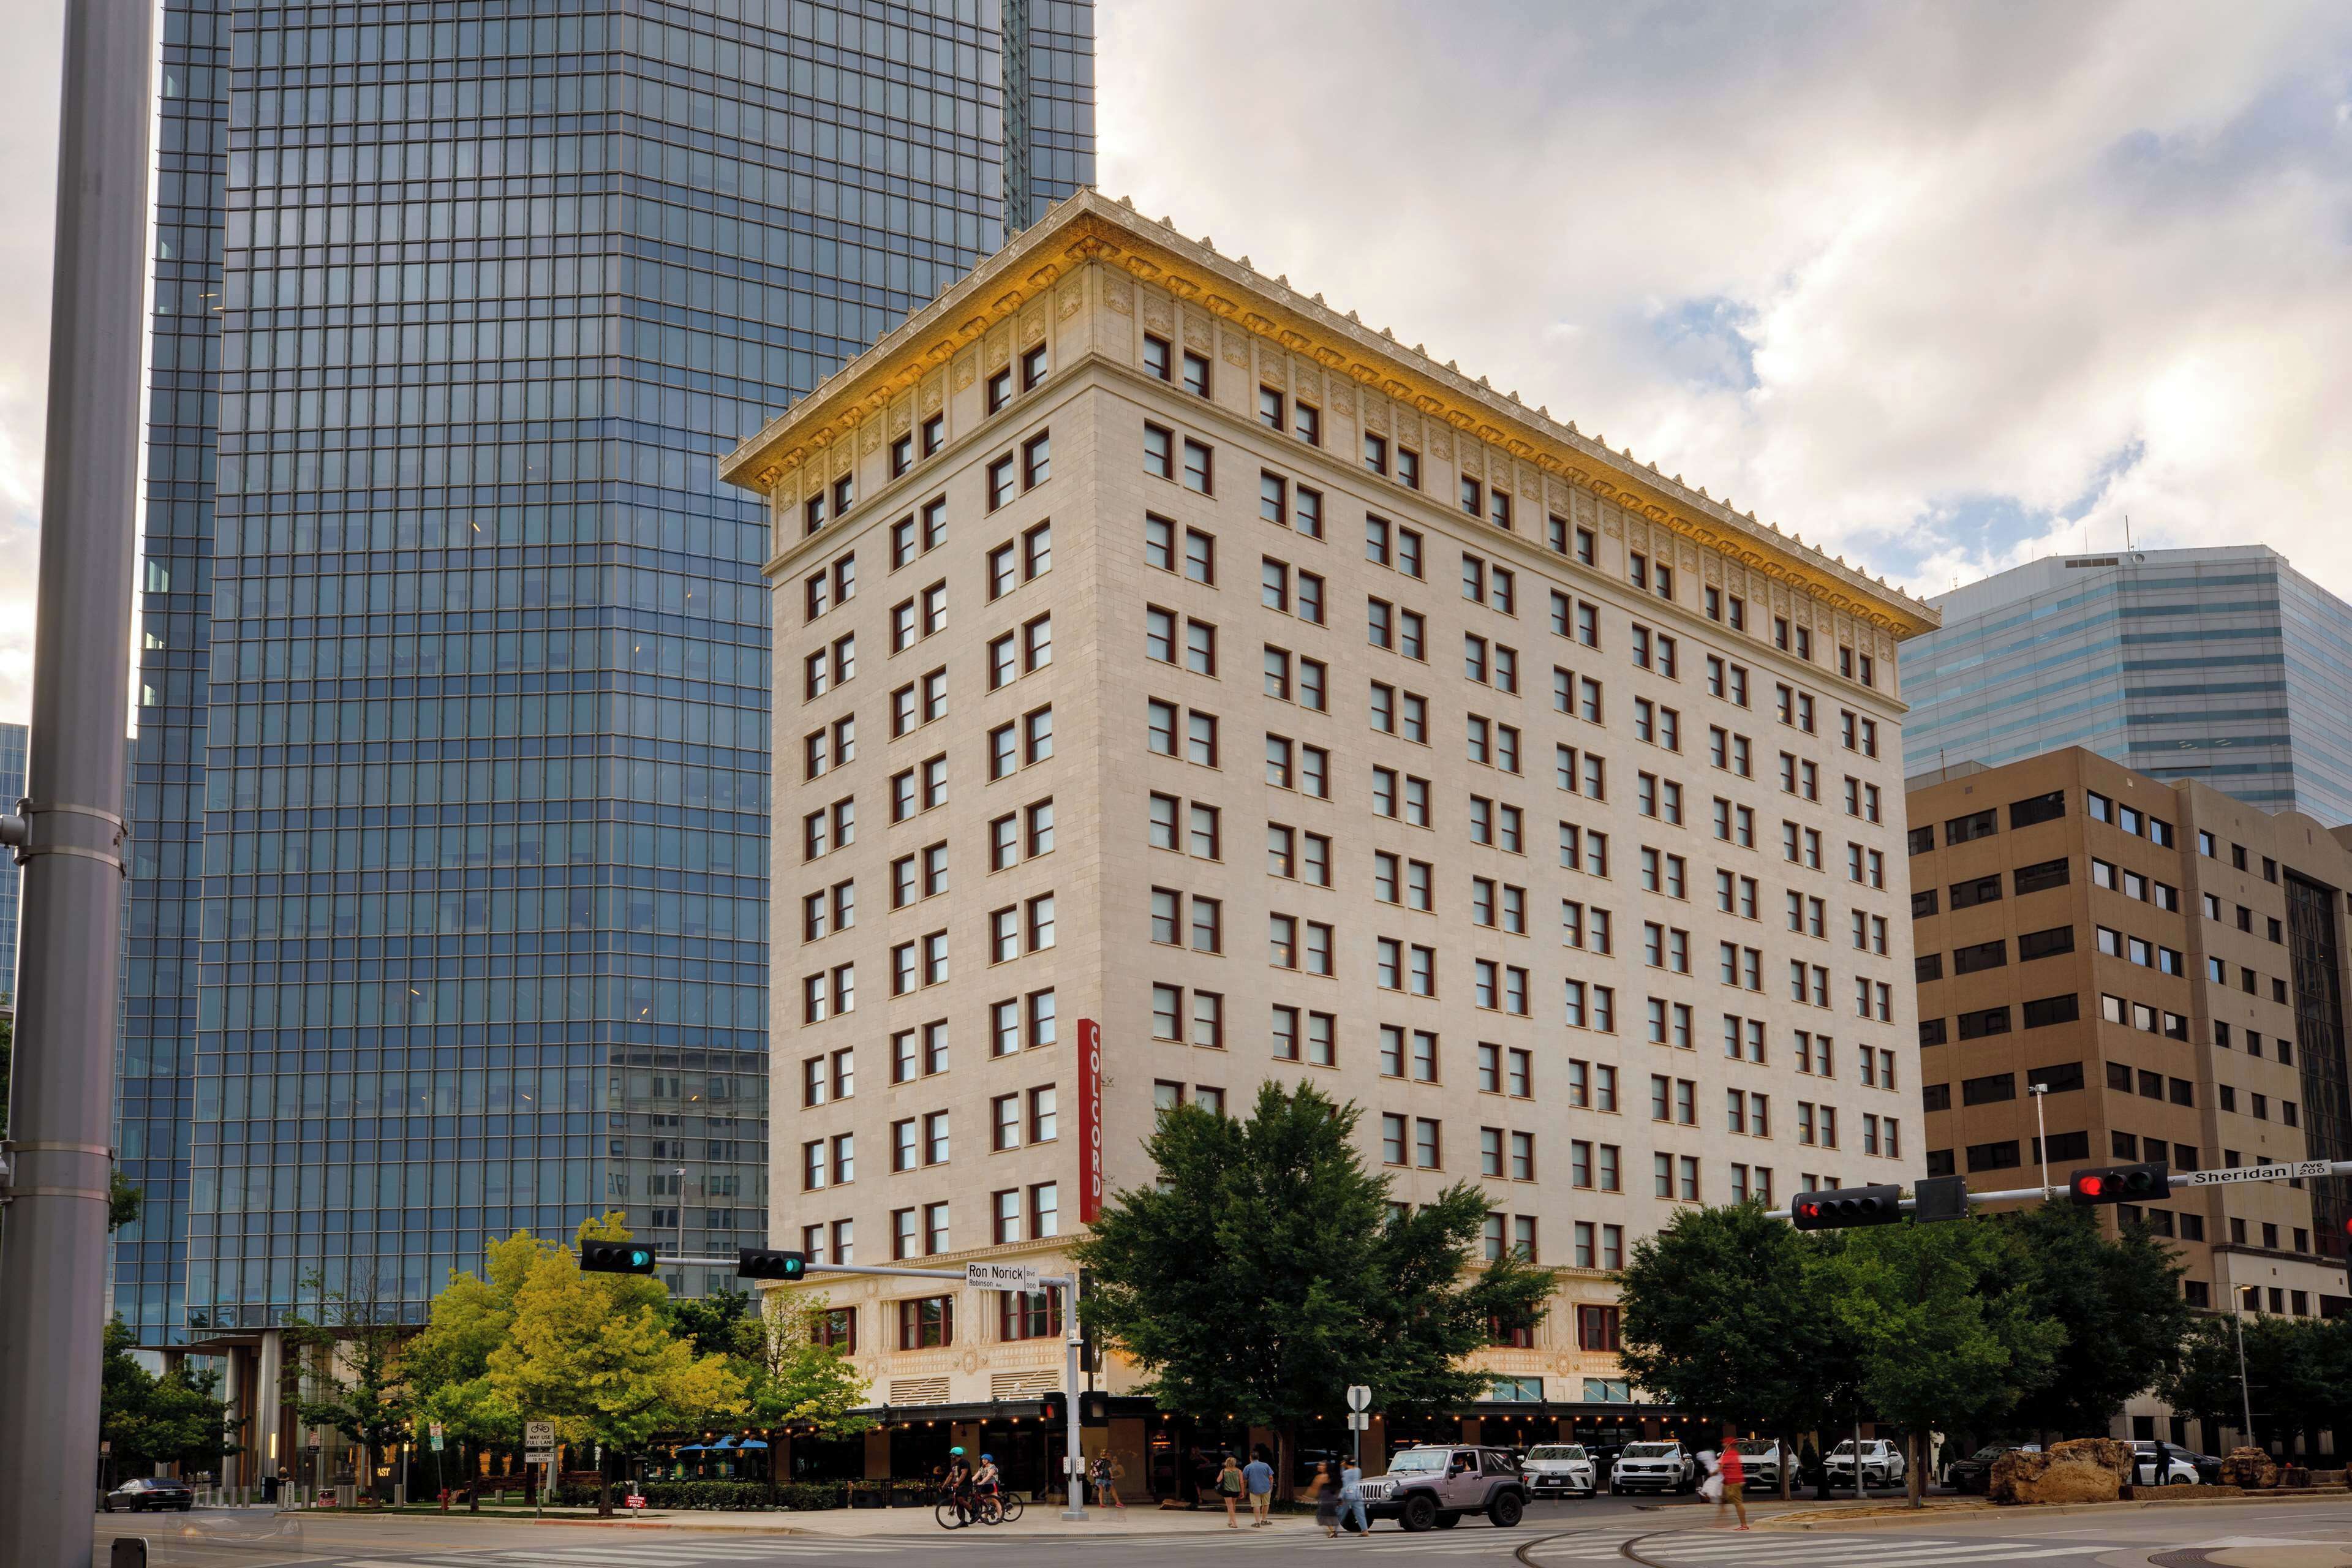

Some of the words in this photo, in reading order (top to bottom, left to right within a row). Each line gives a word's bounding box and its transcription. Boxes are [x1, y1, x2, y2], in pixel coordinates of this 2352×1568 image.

[1090, 1025, 1101, 1197] COLCORD
[2195, 1168, 2286, 1183] Sheridan
[969, 1264, 987, 1278] Ron
[992, 1265, 1023, 1280] Norick
[377, 1467, 391, 1476] AST
